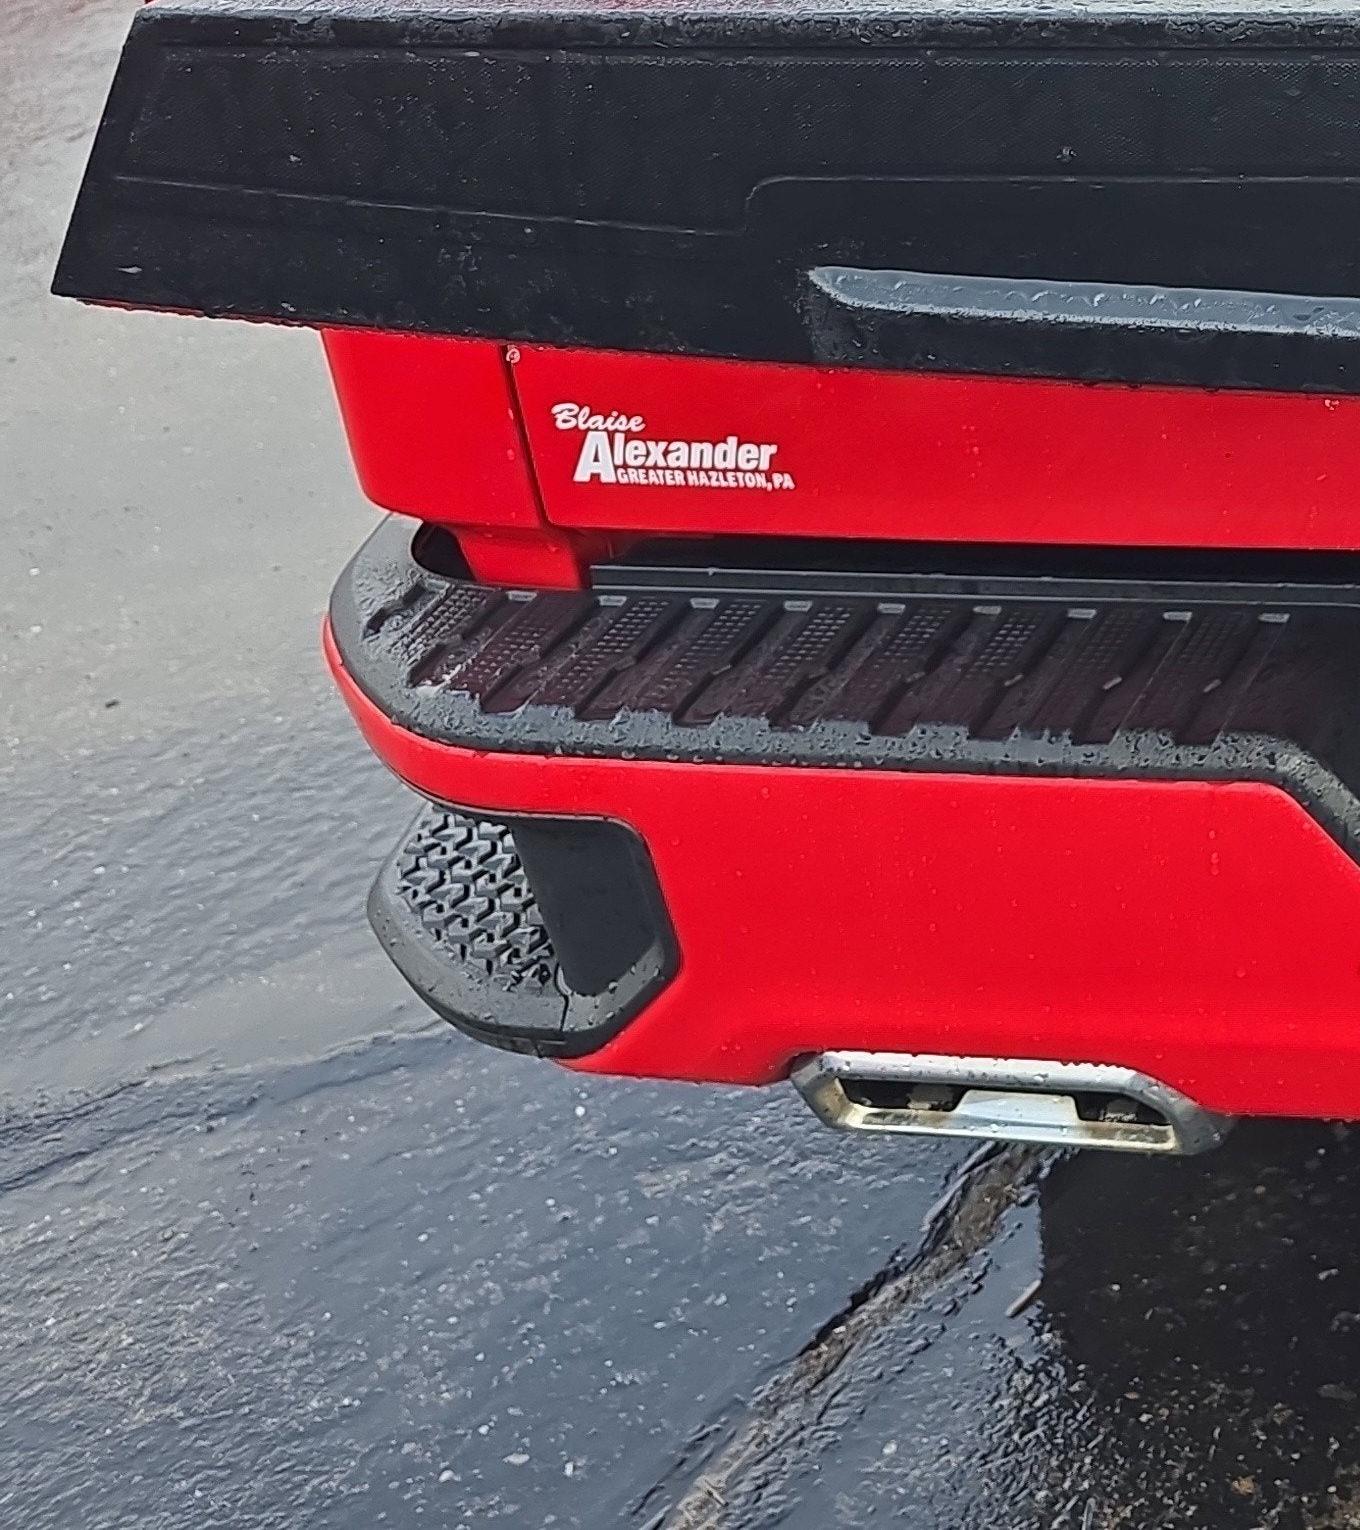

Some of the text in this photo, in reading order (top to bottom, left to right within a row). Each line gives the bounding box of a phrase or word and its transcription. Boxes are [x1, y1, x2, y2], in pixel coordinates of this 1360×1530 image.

[551, 402, 646, 432] Blaise
[573, 431, 778, 483] Alexander
[616, 467, 687, 486] GREATER
